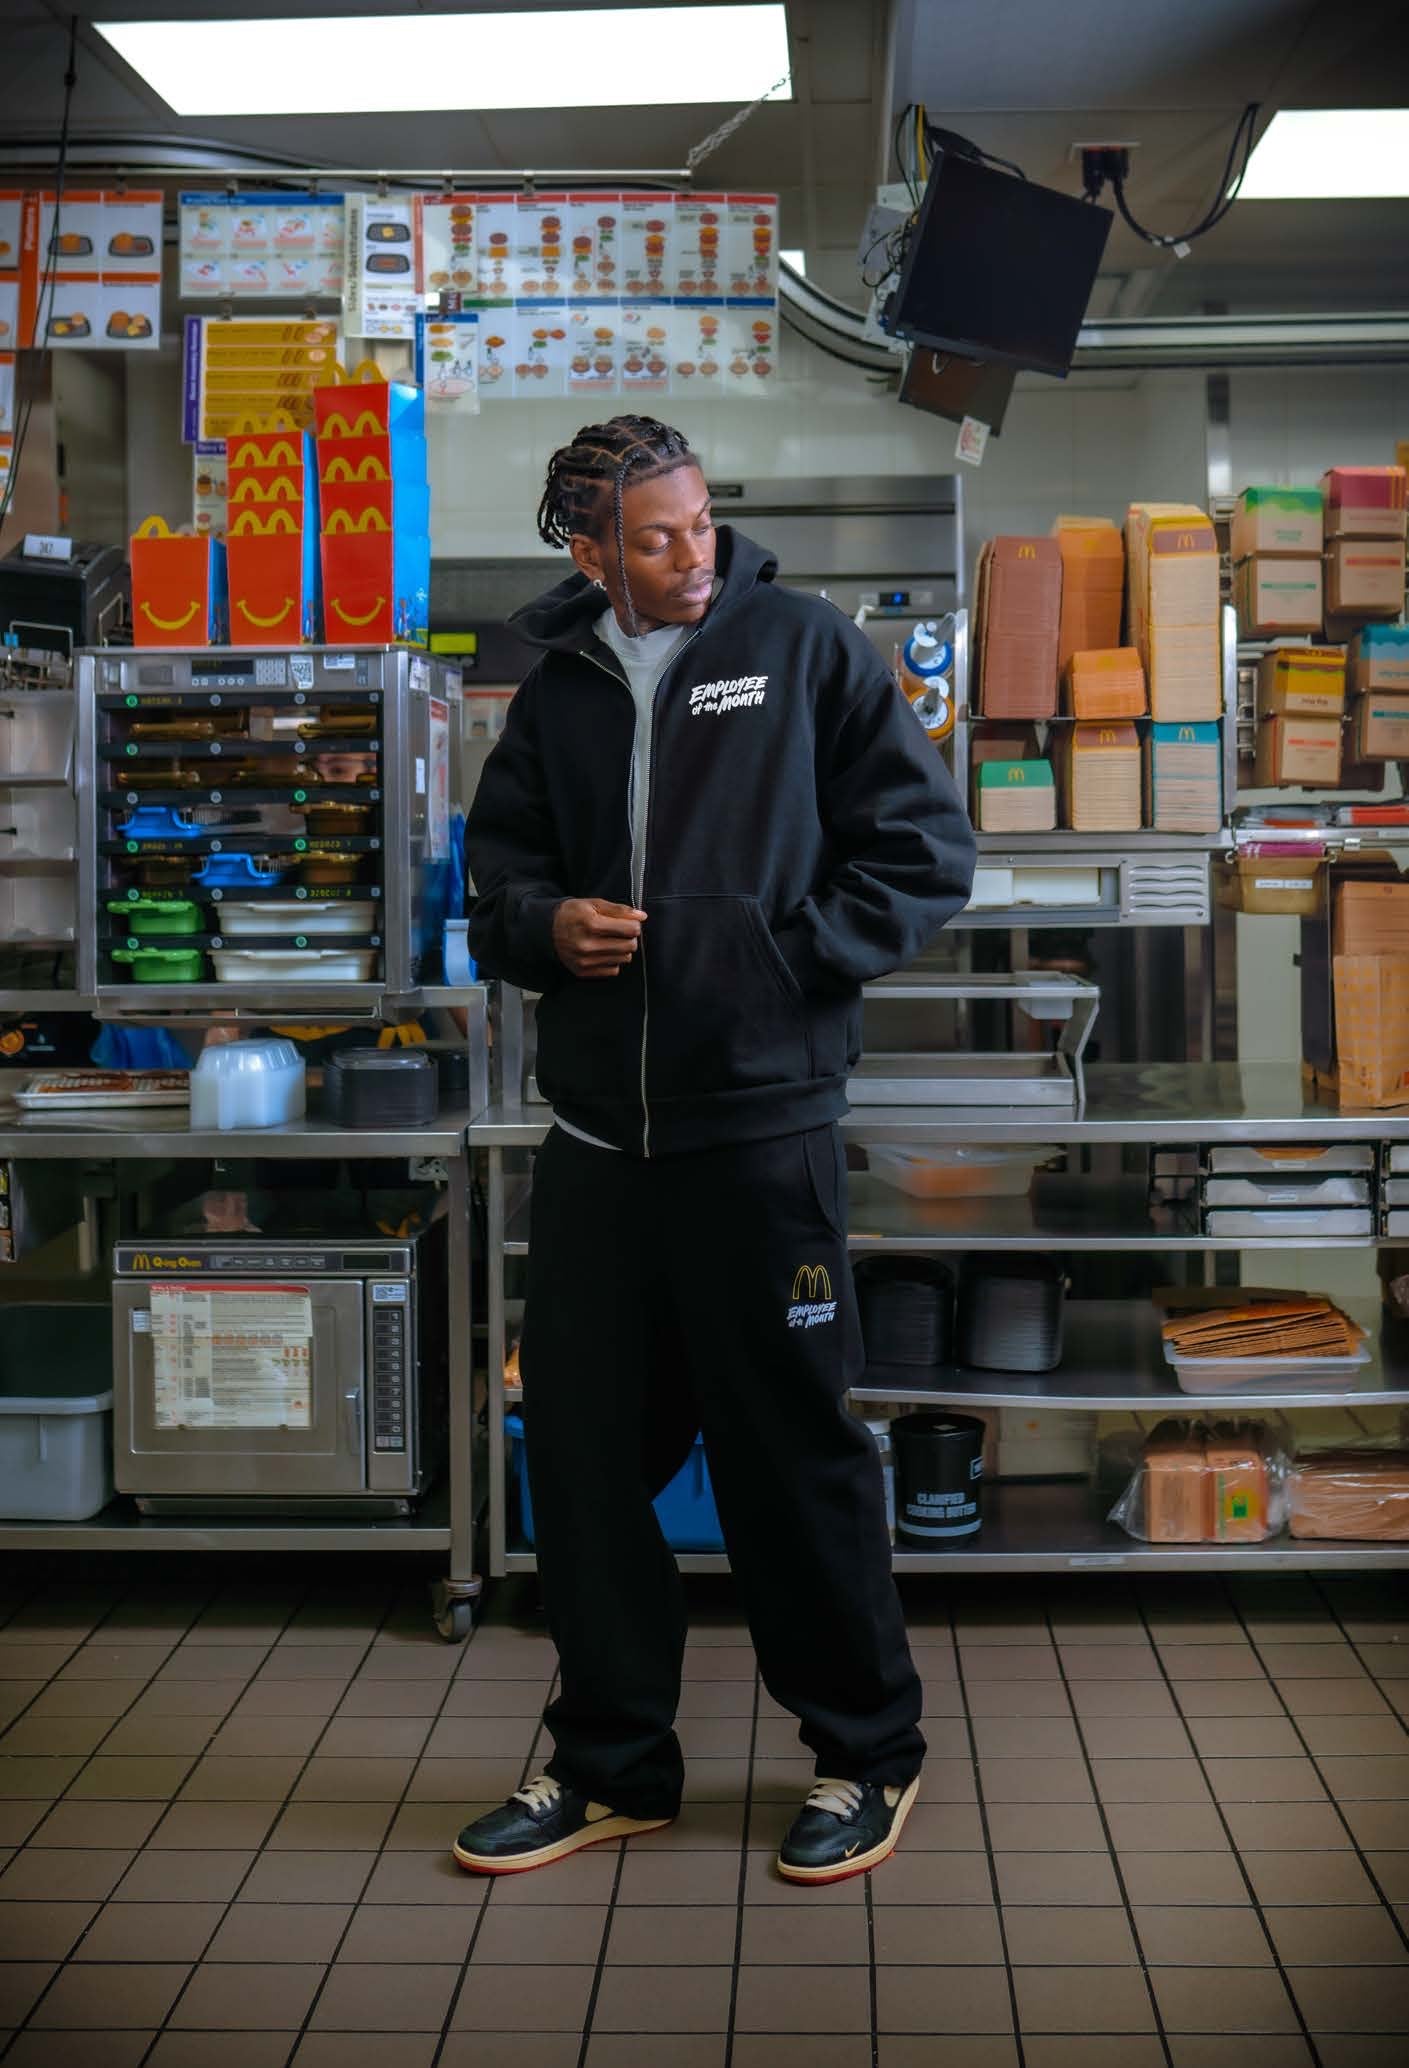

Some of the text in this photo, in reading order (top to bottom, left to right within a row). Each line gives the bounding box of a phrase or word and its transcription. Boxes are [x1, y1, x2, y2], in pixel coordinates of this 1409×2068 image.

[688, 675, 769, 705] EMPLOYEE
[691, 690, 765, 715] of the MONTH
[786, 1301, 838, 1320] EMPLOYEE
[804, 1311, 835, 1329] MONTH
